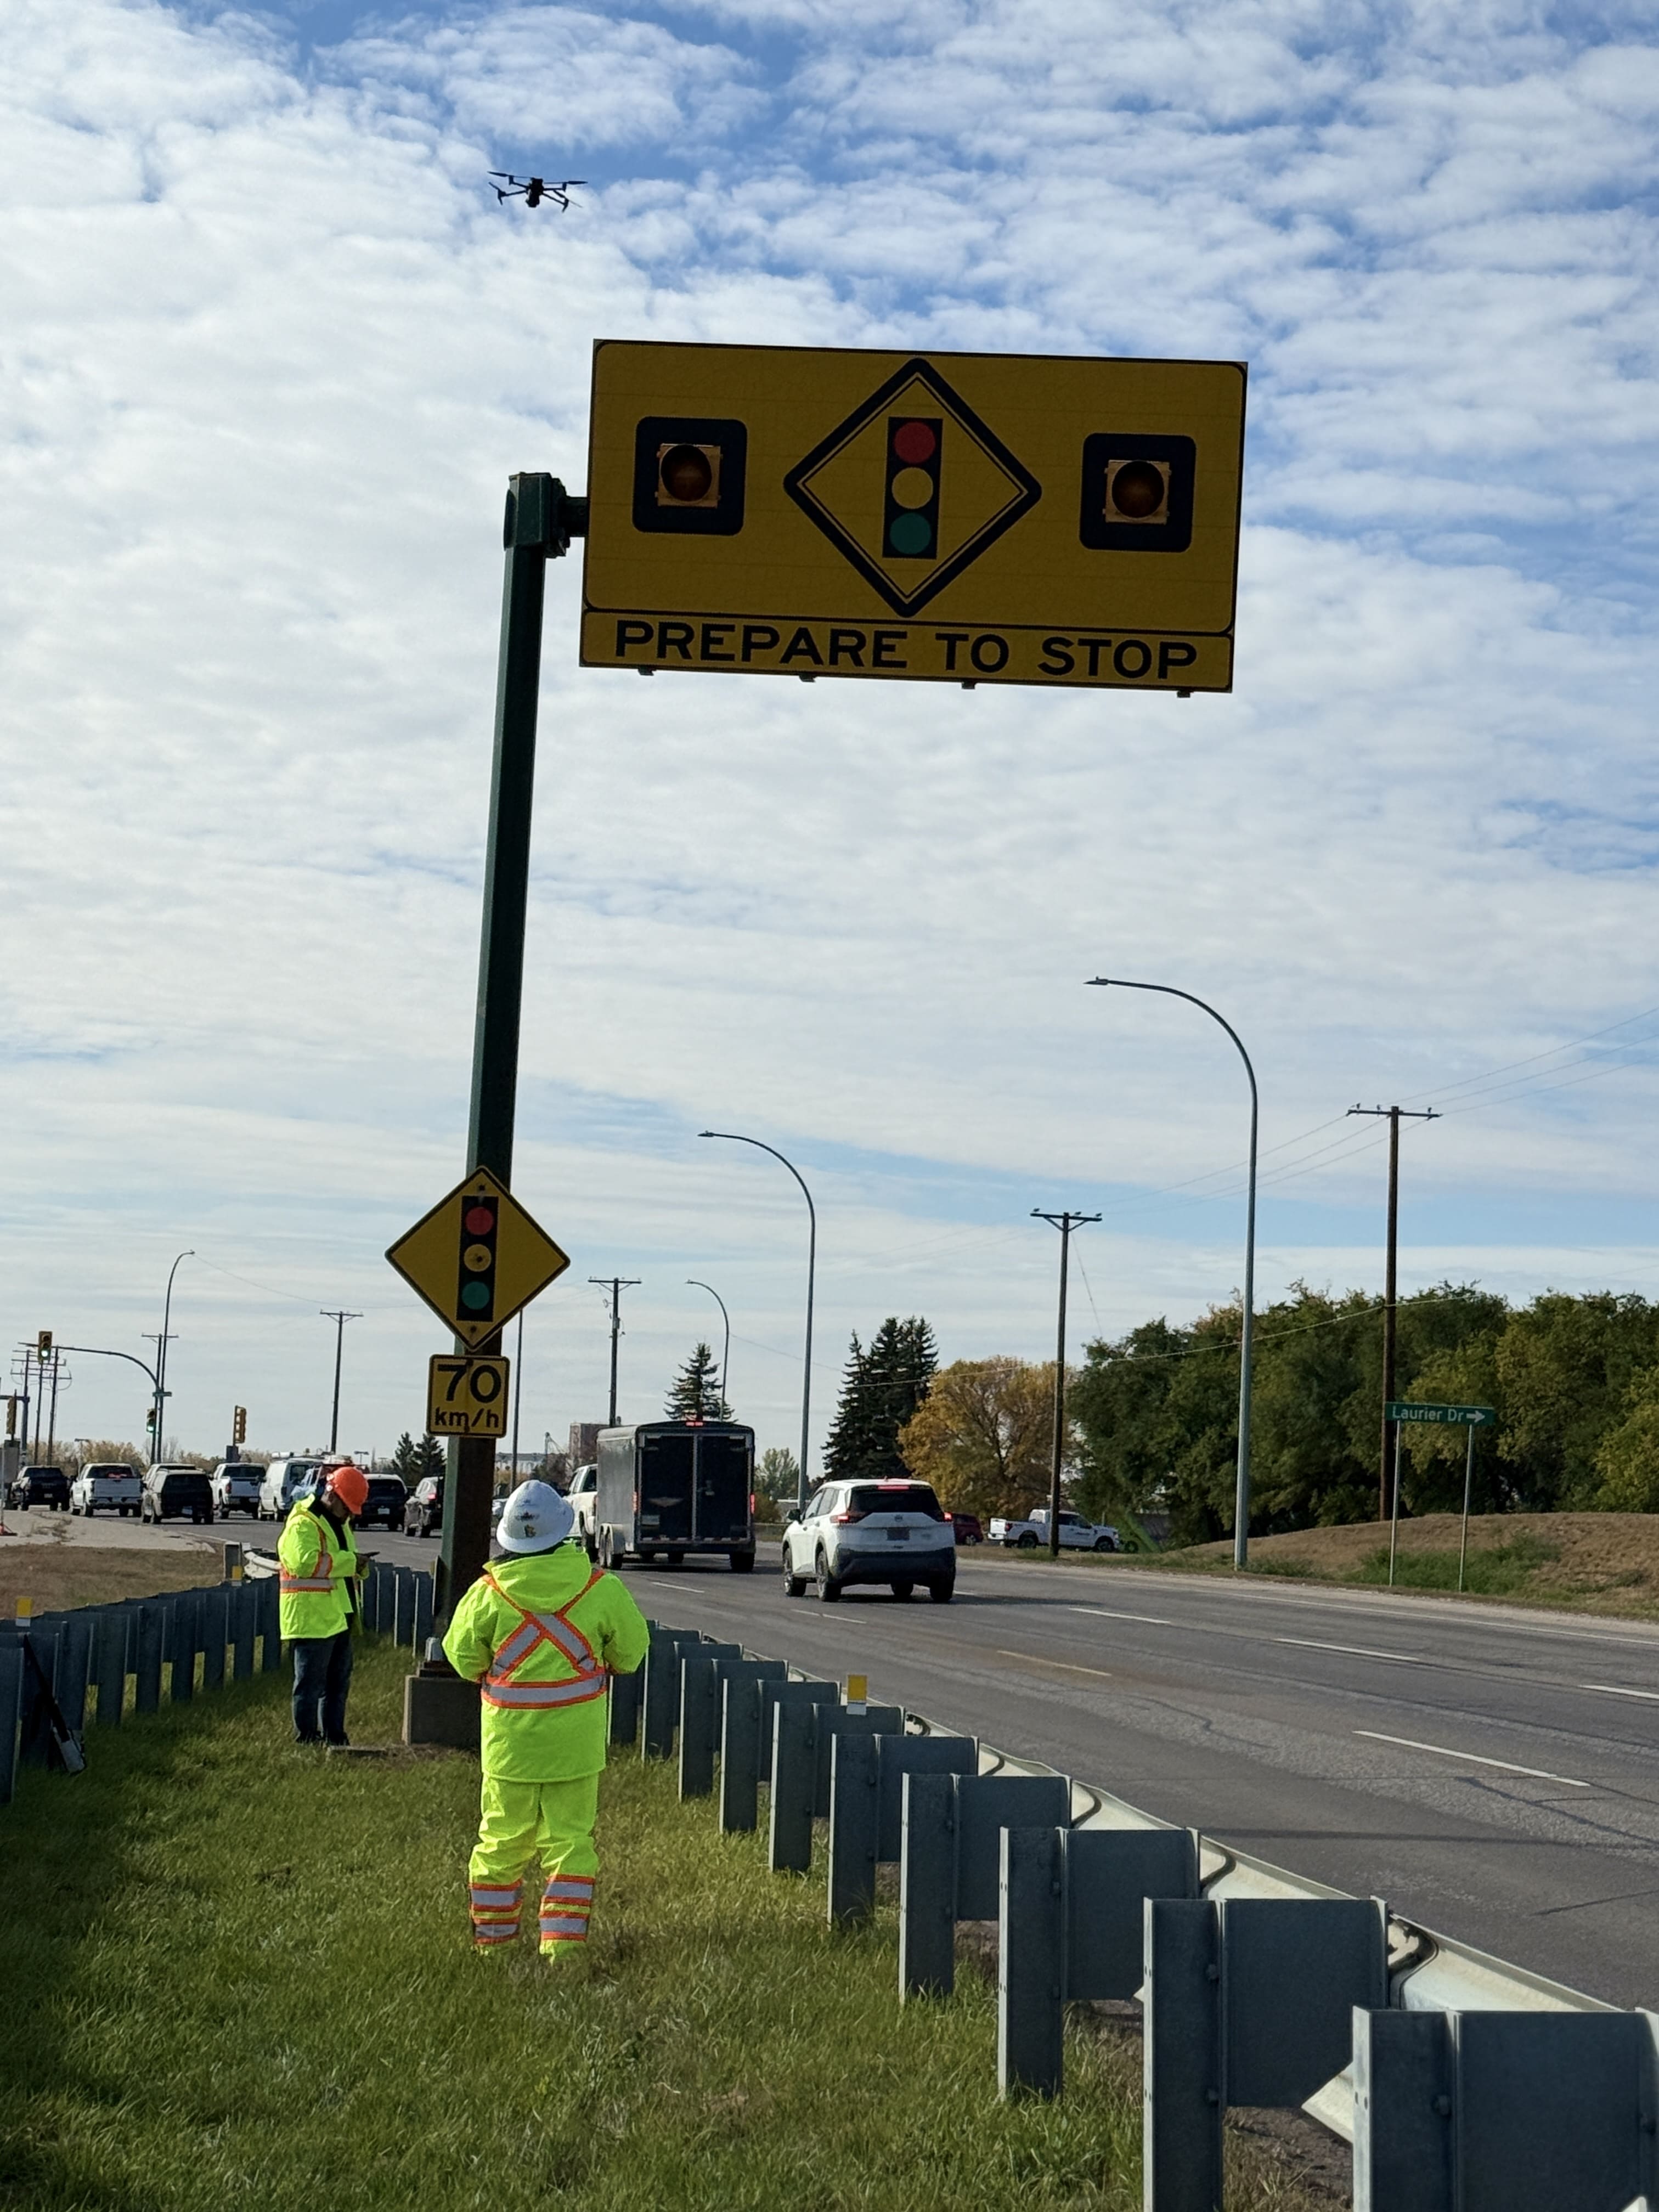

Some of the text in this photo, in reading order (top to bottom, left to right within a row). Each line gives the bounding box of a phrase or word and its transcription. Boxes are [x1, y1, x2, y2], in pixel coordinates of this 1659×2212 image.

[615, 619, 1197, 680] PREPARE TO STOP
[437, 1364, 501, 1403] 70
[435, 1407, 499, 1428] km/h
[1392, 1406, 1464, 1421] Laurier Dr
